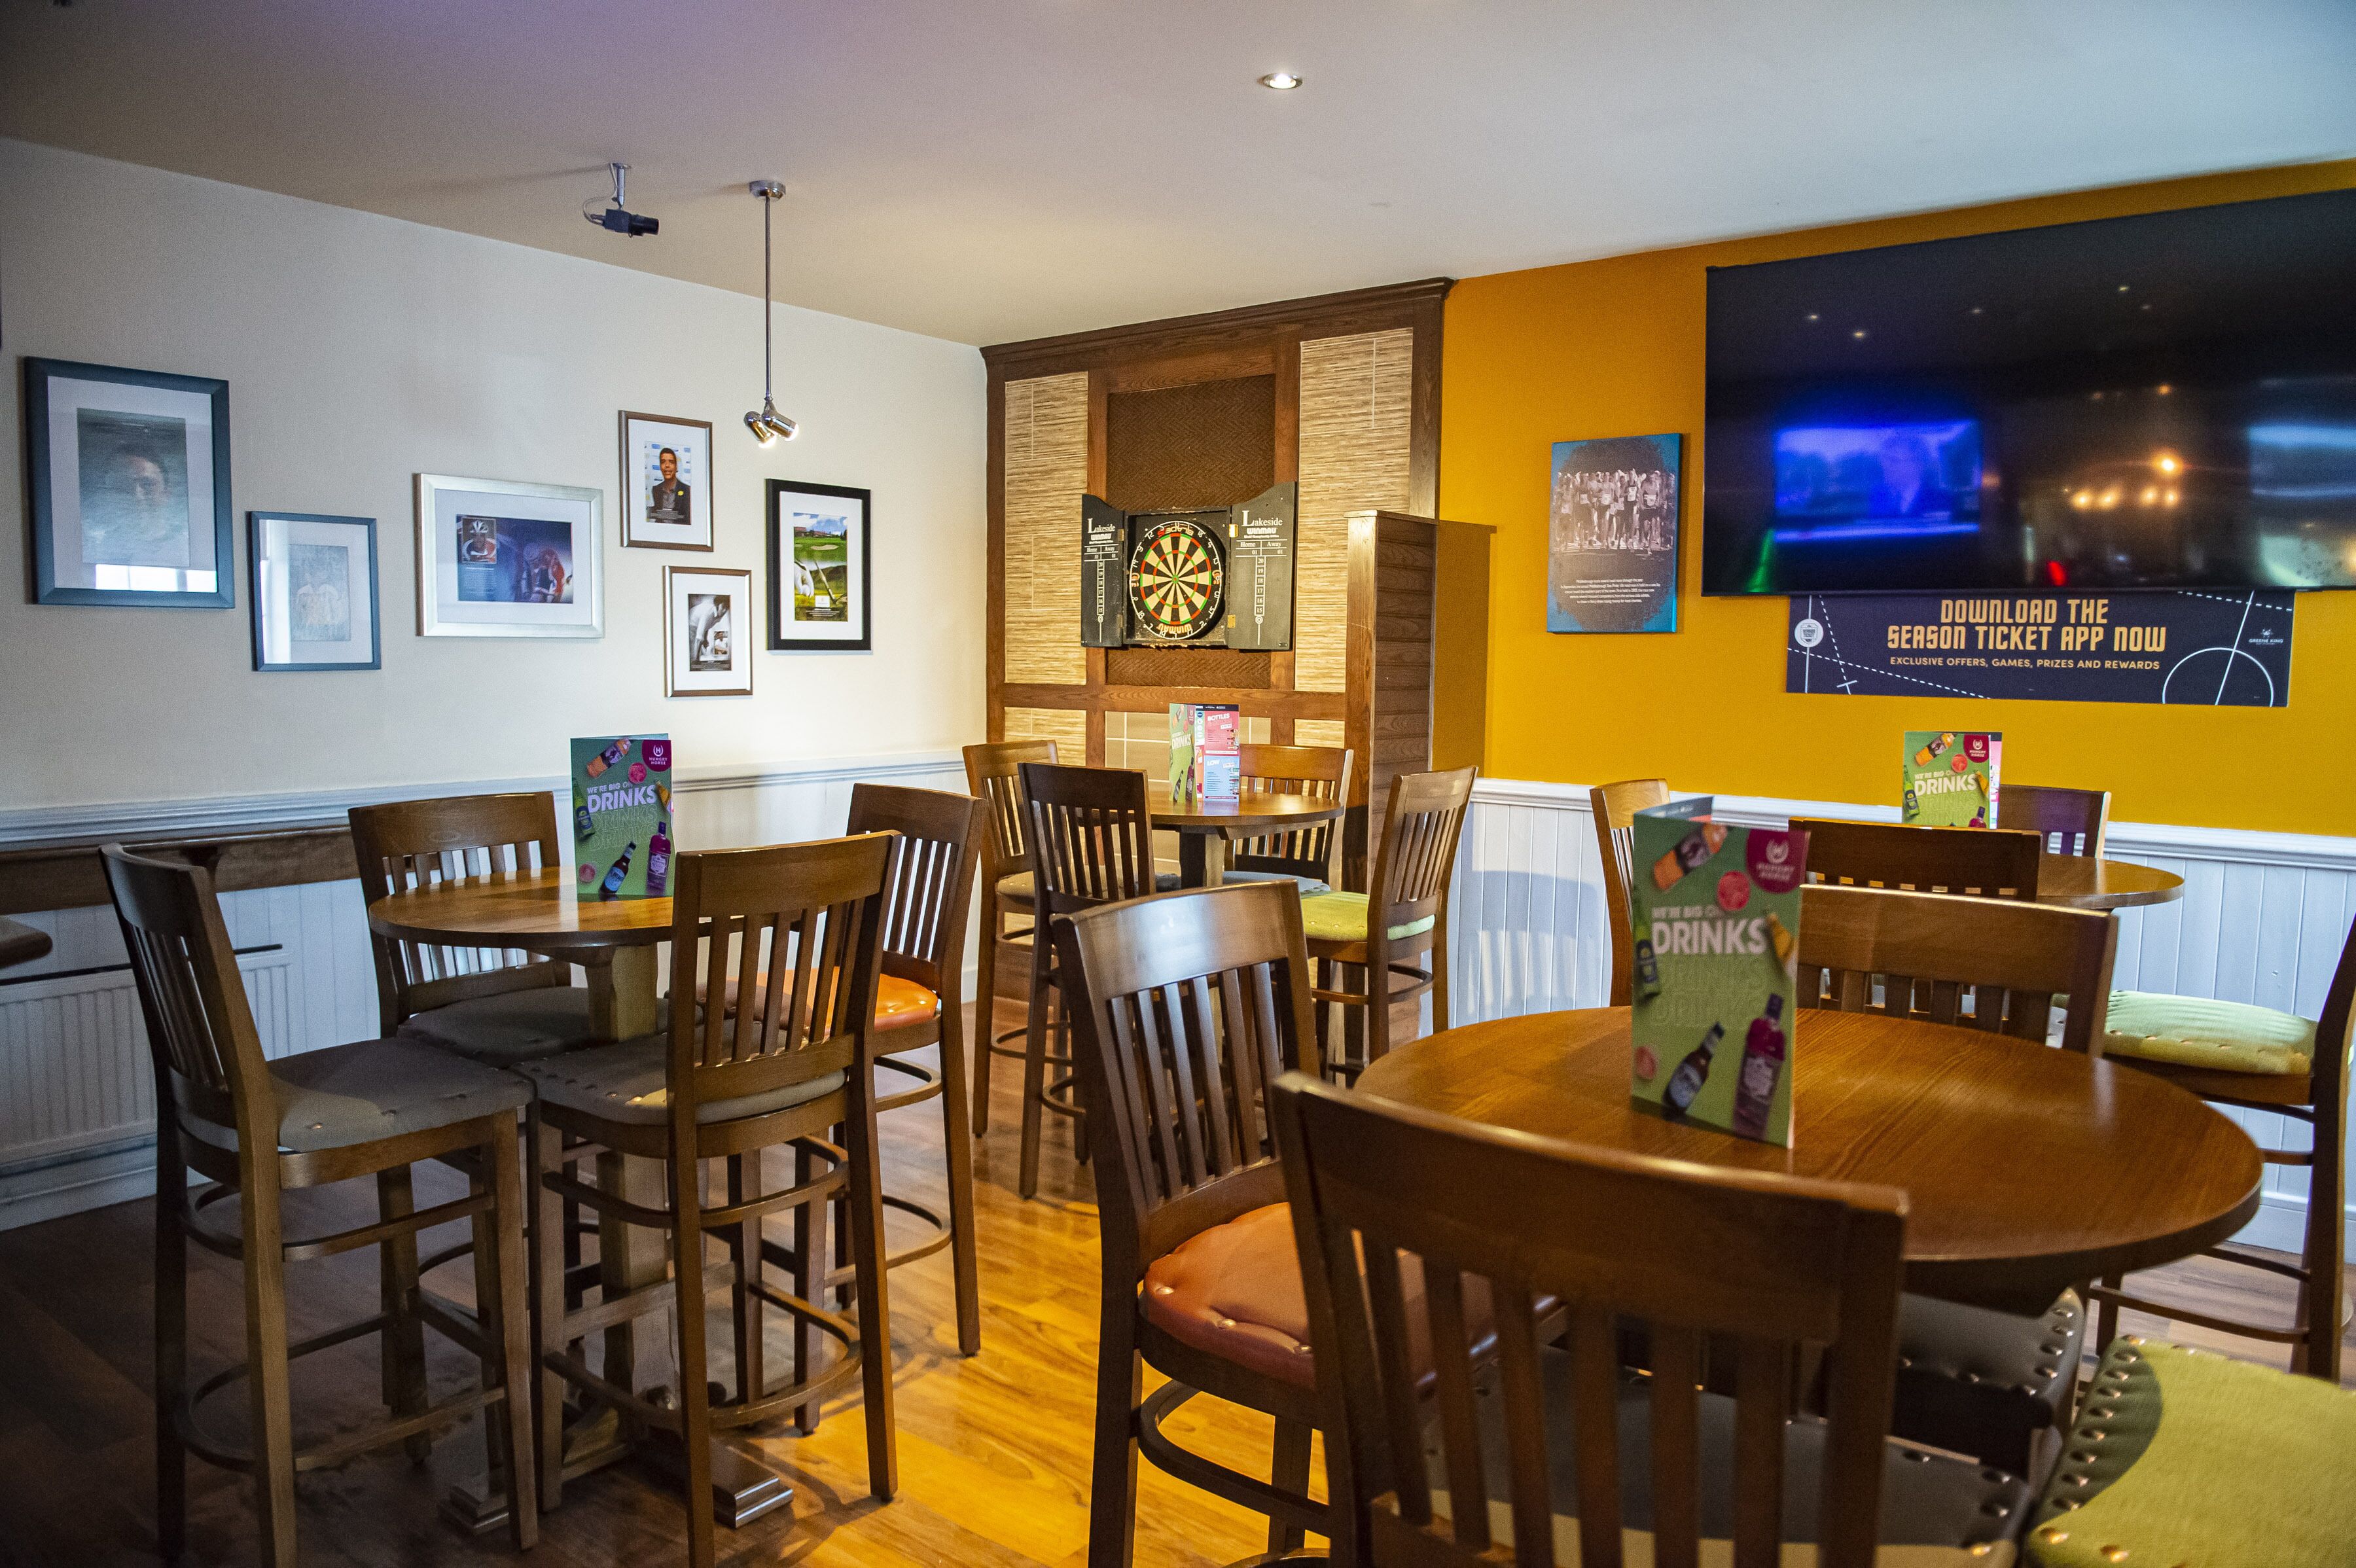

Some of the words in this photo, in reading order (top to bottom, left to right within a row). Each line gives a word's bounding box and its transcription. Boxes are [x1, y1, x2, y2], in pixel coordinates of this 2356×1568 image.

[1087, 518, 1116, 534] Lakeside
[1241, 510, 1283, 527] Lakeside
[1940, 599, 2058, 624] DOWNLOAD
[2067, 599, 2109, 624] THE
[1887, 625, 1966, 649] SEASON
[1975, 626, 2052, 650] TICKET
[2061, 626, 2104, 651] APP
[2113, 626, 2166, 652] NOW
[1890, 657, 1943, 666] EXCLUSIVE
[1946, 658, 1988, 667] OFFERS,
[1991, 658, 2033, 668] GAMES,
[2037, 659, 2074, 668] PRIZES
[2077, 660, 2101, 668] AND
[2104, 660, 2160, 669] REWARDS
[1172, 734, 1191, 749] DRINKS
[587, 785, 607, 794] WE'RE
[1914, 774, 1977, 796] DRINKS
[588, 785, 657, 813] DRINKS
[1652, 917, 1768, 955] DRINKS
